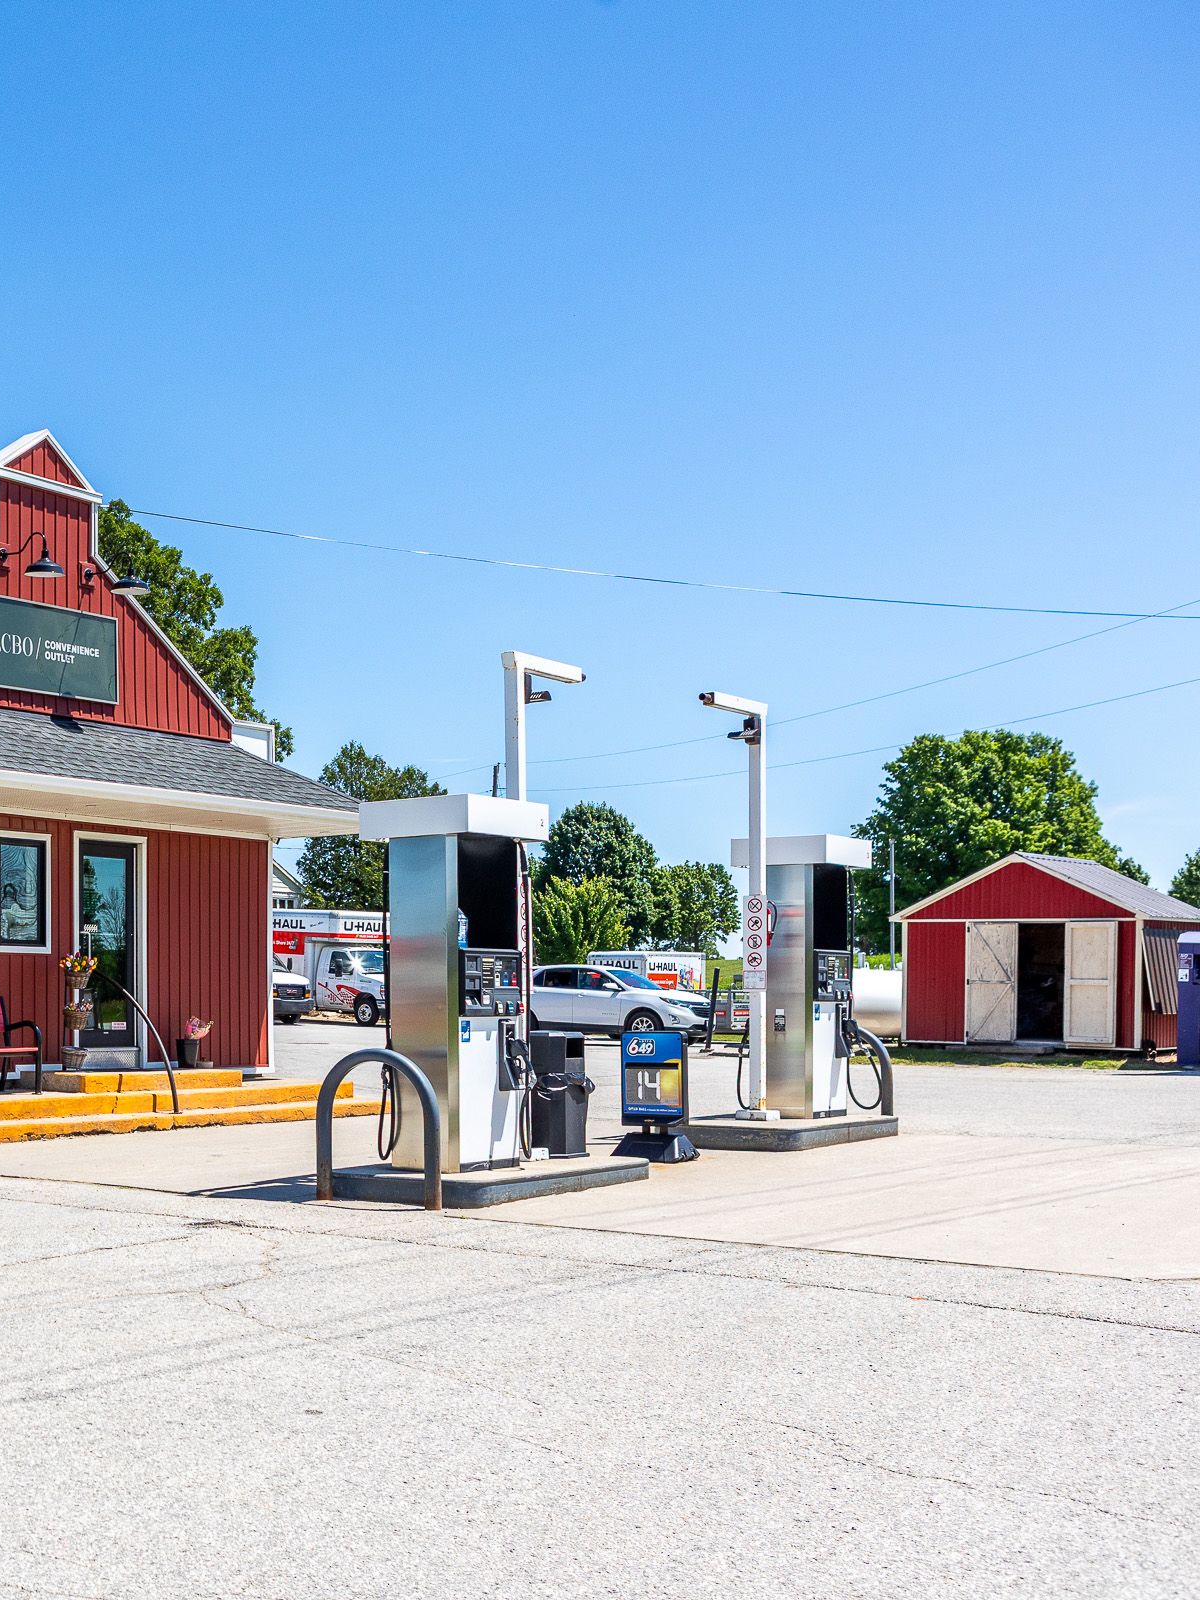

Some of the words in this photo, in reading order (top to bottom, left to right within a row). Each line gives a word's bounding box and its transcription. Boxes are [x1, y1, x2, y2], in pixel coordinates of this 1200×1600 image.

[44, 639, 100, 658] CONVENIENCE
[44, 651, 75, 664] OUTLET
[273, 918, 306, 930] HAUL
[649, 962, 677, 971] U-HAUL
[637, 1070, 661, 1100] 14
